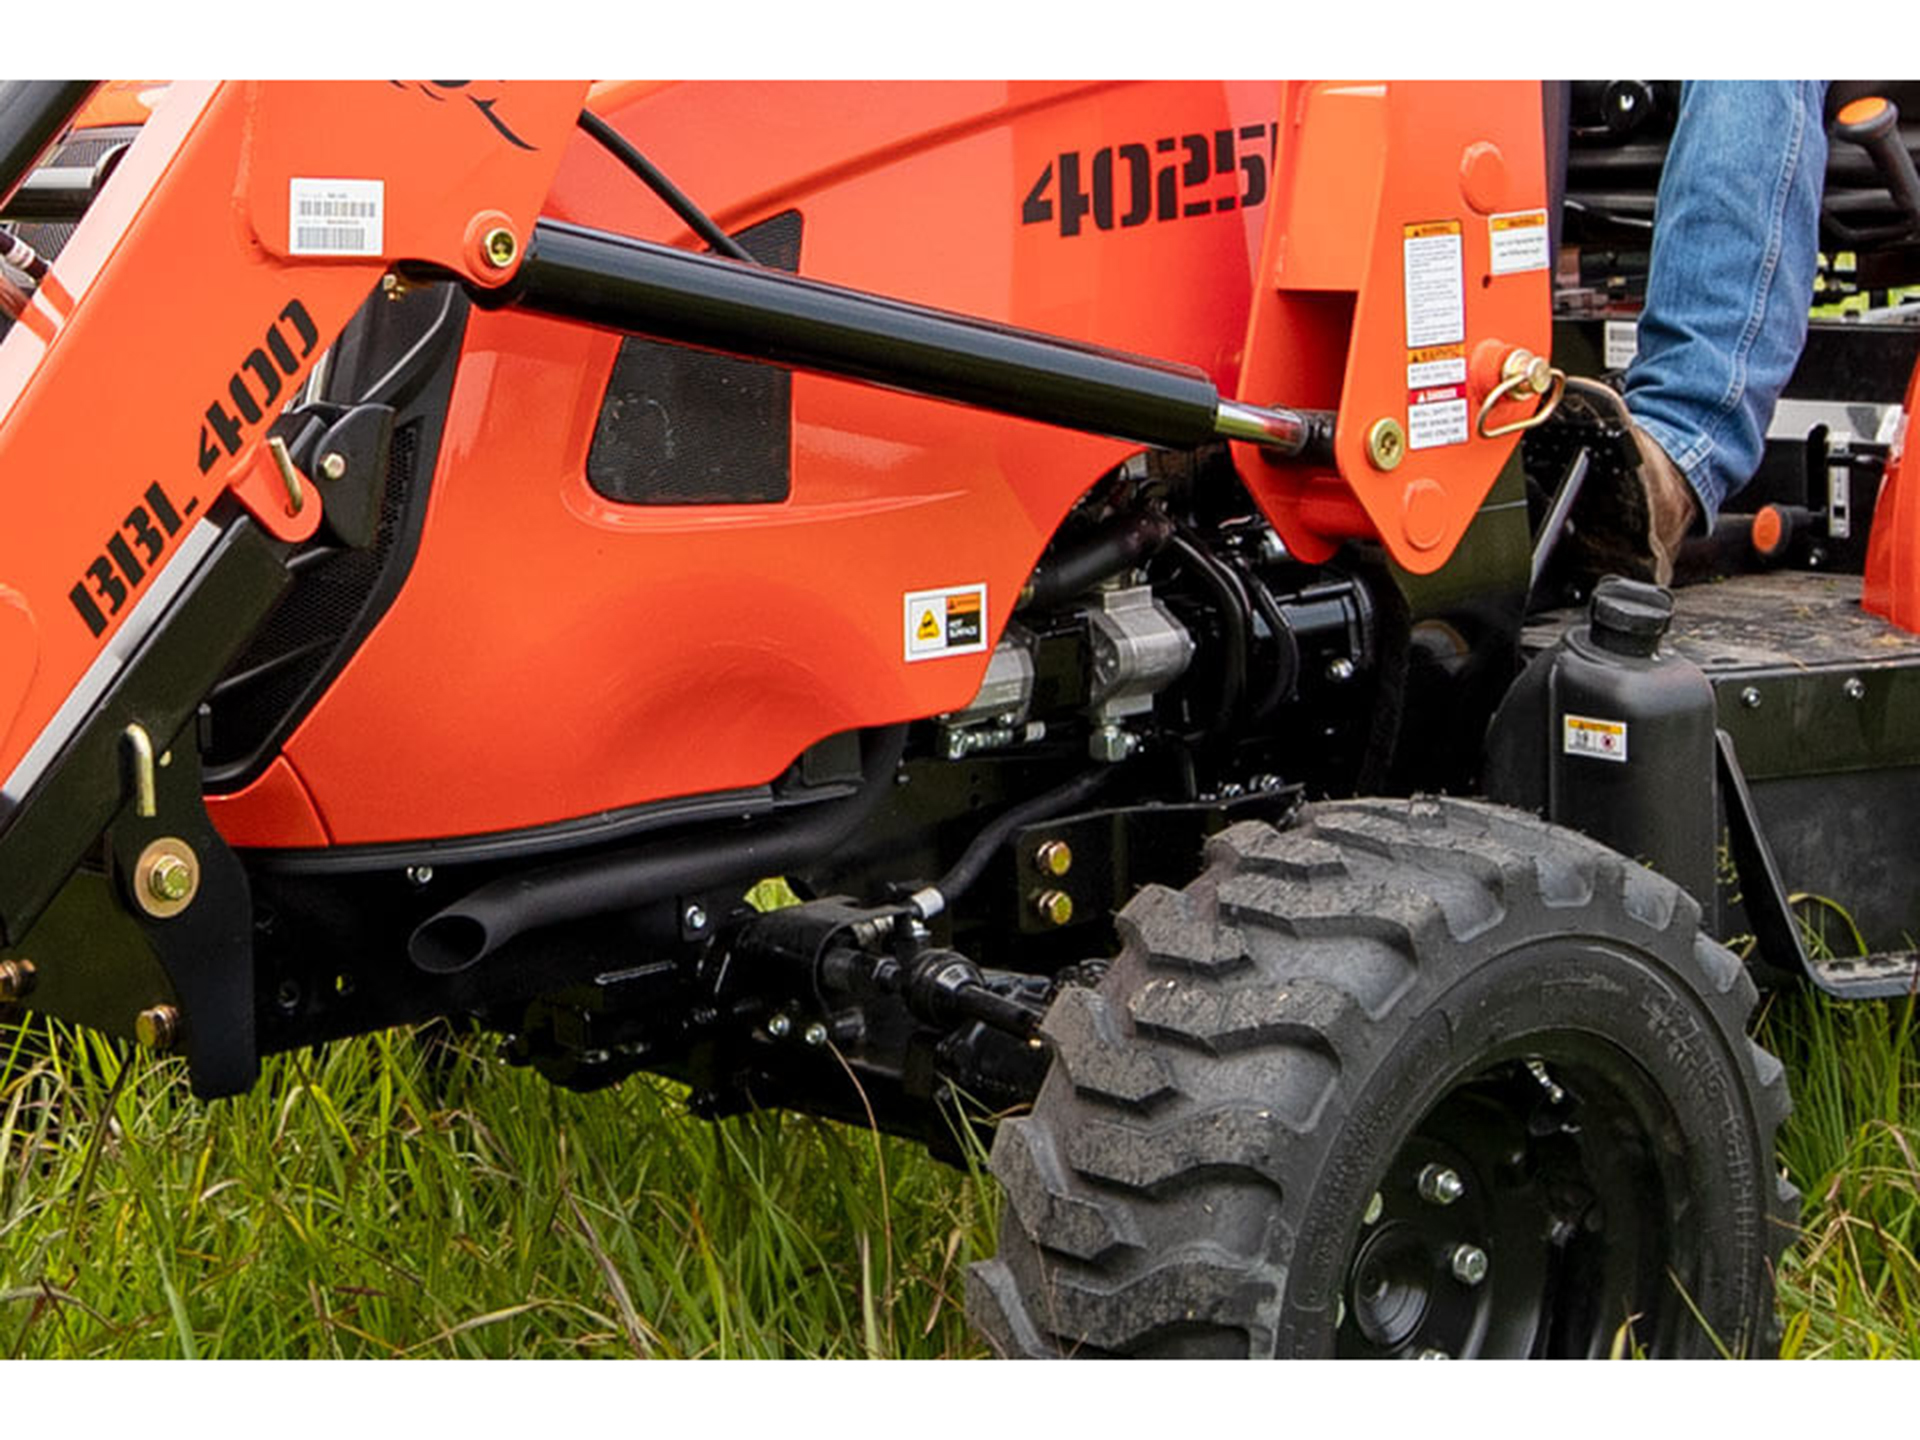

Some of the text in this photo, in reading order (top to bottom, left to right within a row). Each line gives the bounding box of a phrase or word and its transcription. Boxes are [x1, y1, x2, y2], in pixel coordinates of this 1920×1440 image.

[1022, 122, 1278, 237] 4025
[68, 298, 319, 639] BBL 400
